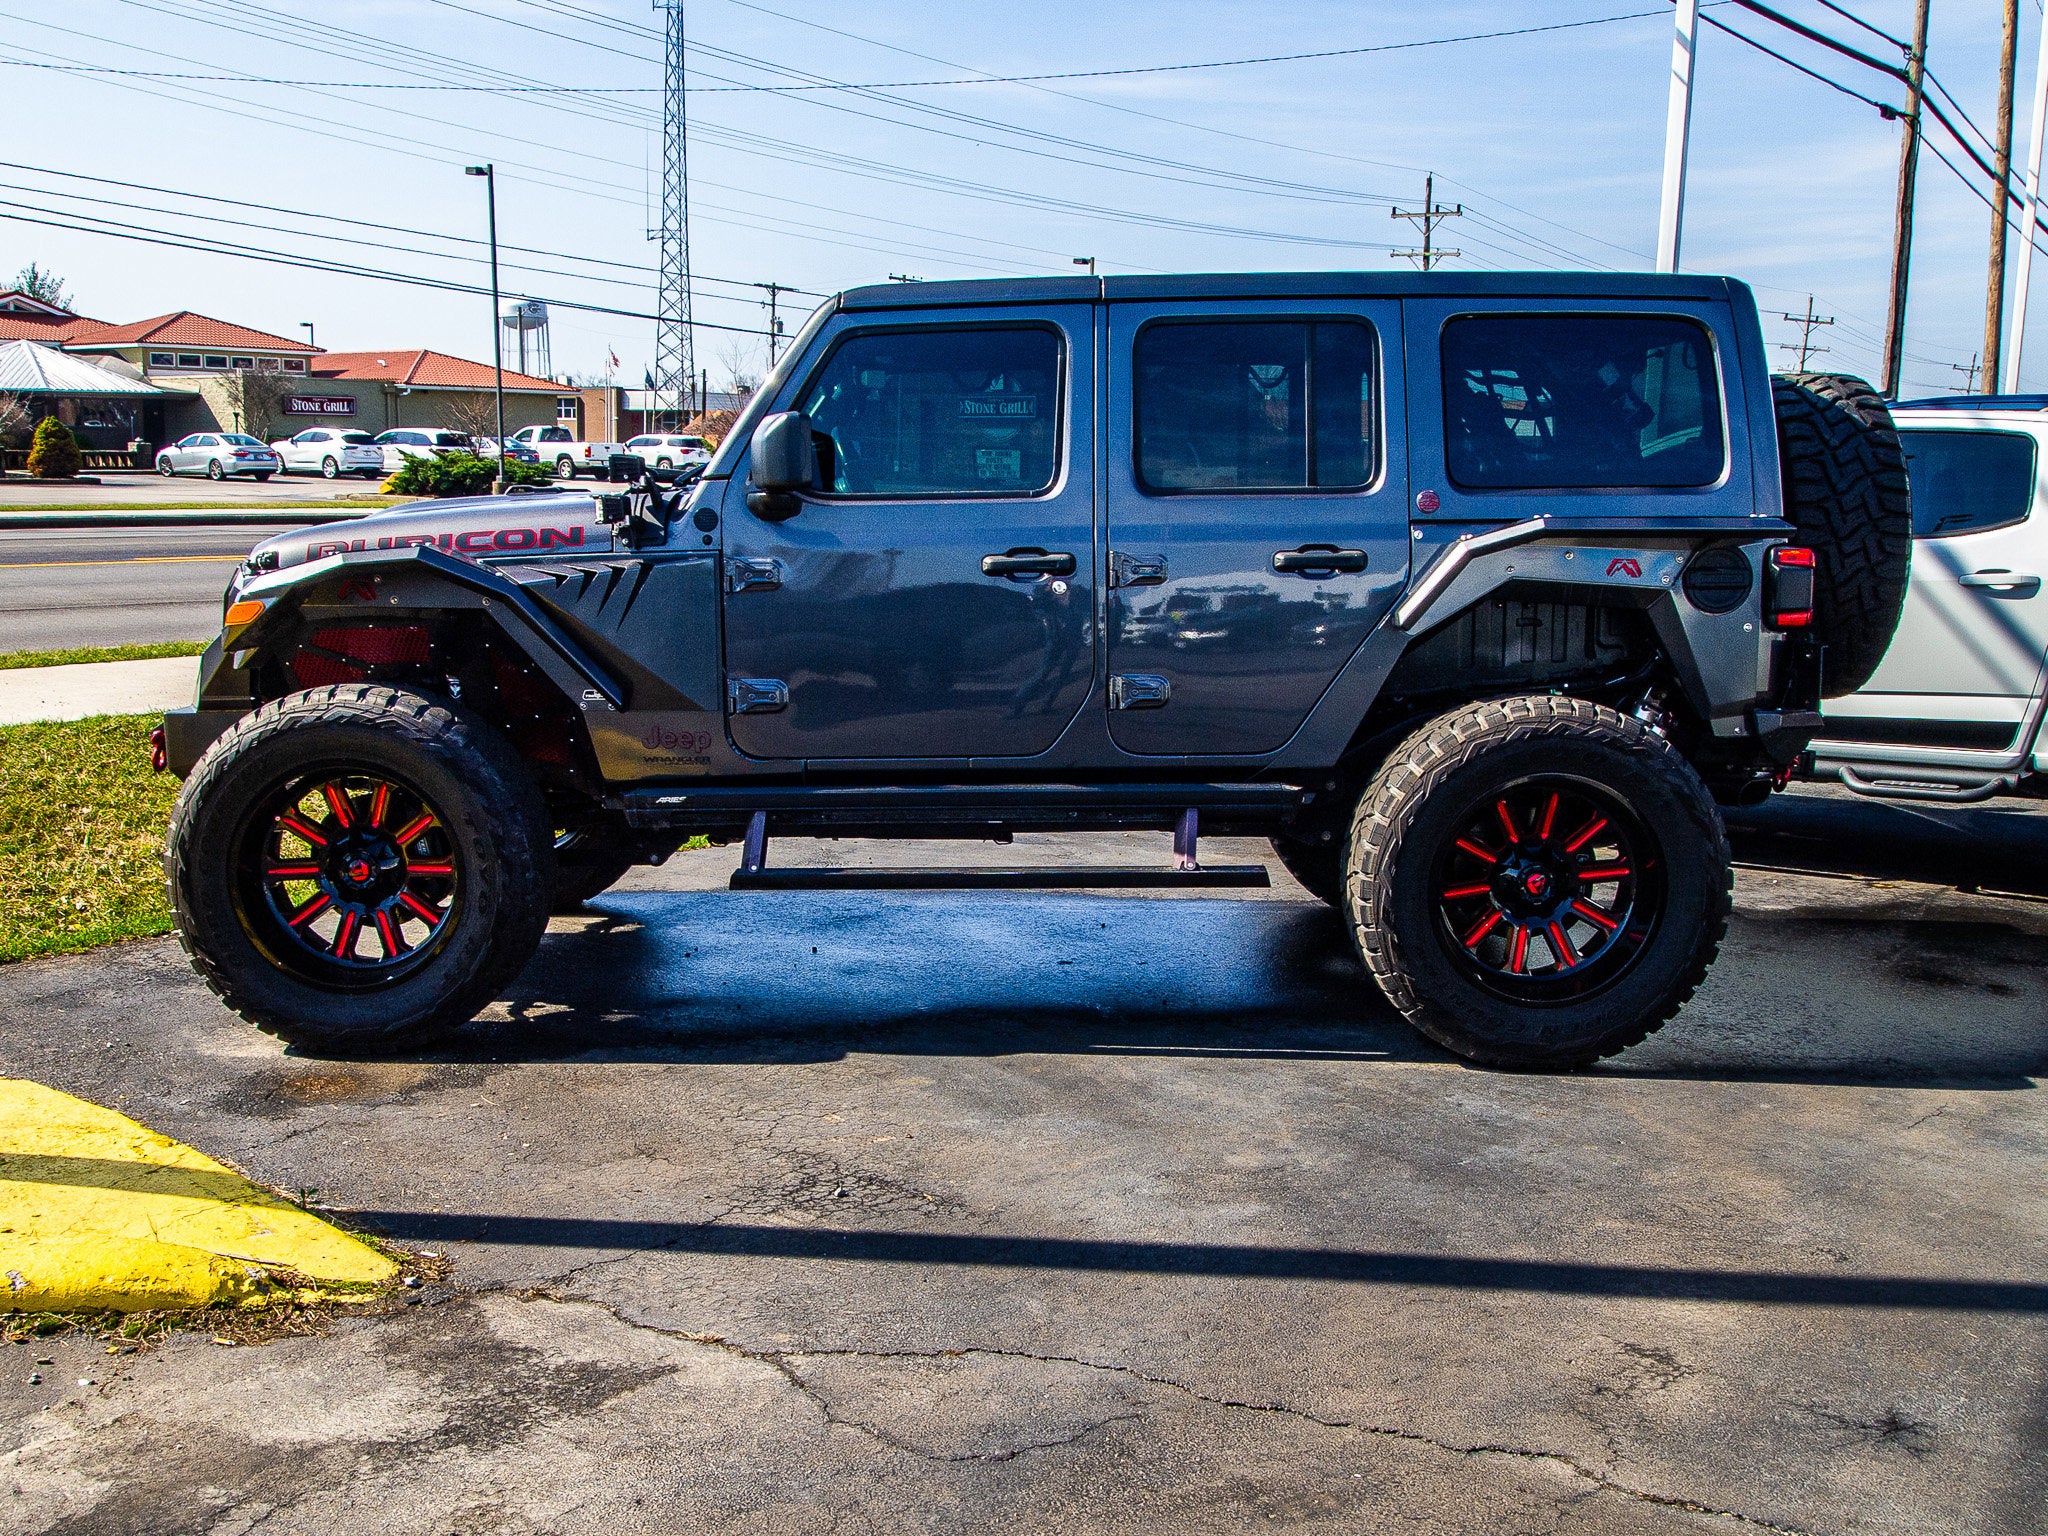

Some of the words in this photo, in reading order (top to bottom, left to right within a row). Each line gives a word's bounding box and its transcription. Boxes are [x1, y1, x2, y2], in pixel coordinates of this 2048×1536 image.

[291, 398, 321, 412] STONE
[323, 401, 350, 412] GRILL
[964, 399, 997, 415] STONE
[999, 400, 1029, 415] GRILL
[640, 722, 712, 754] Jeep
